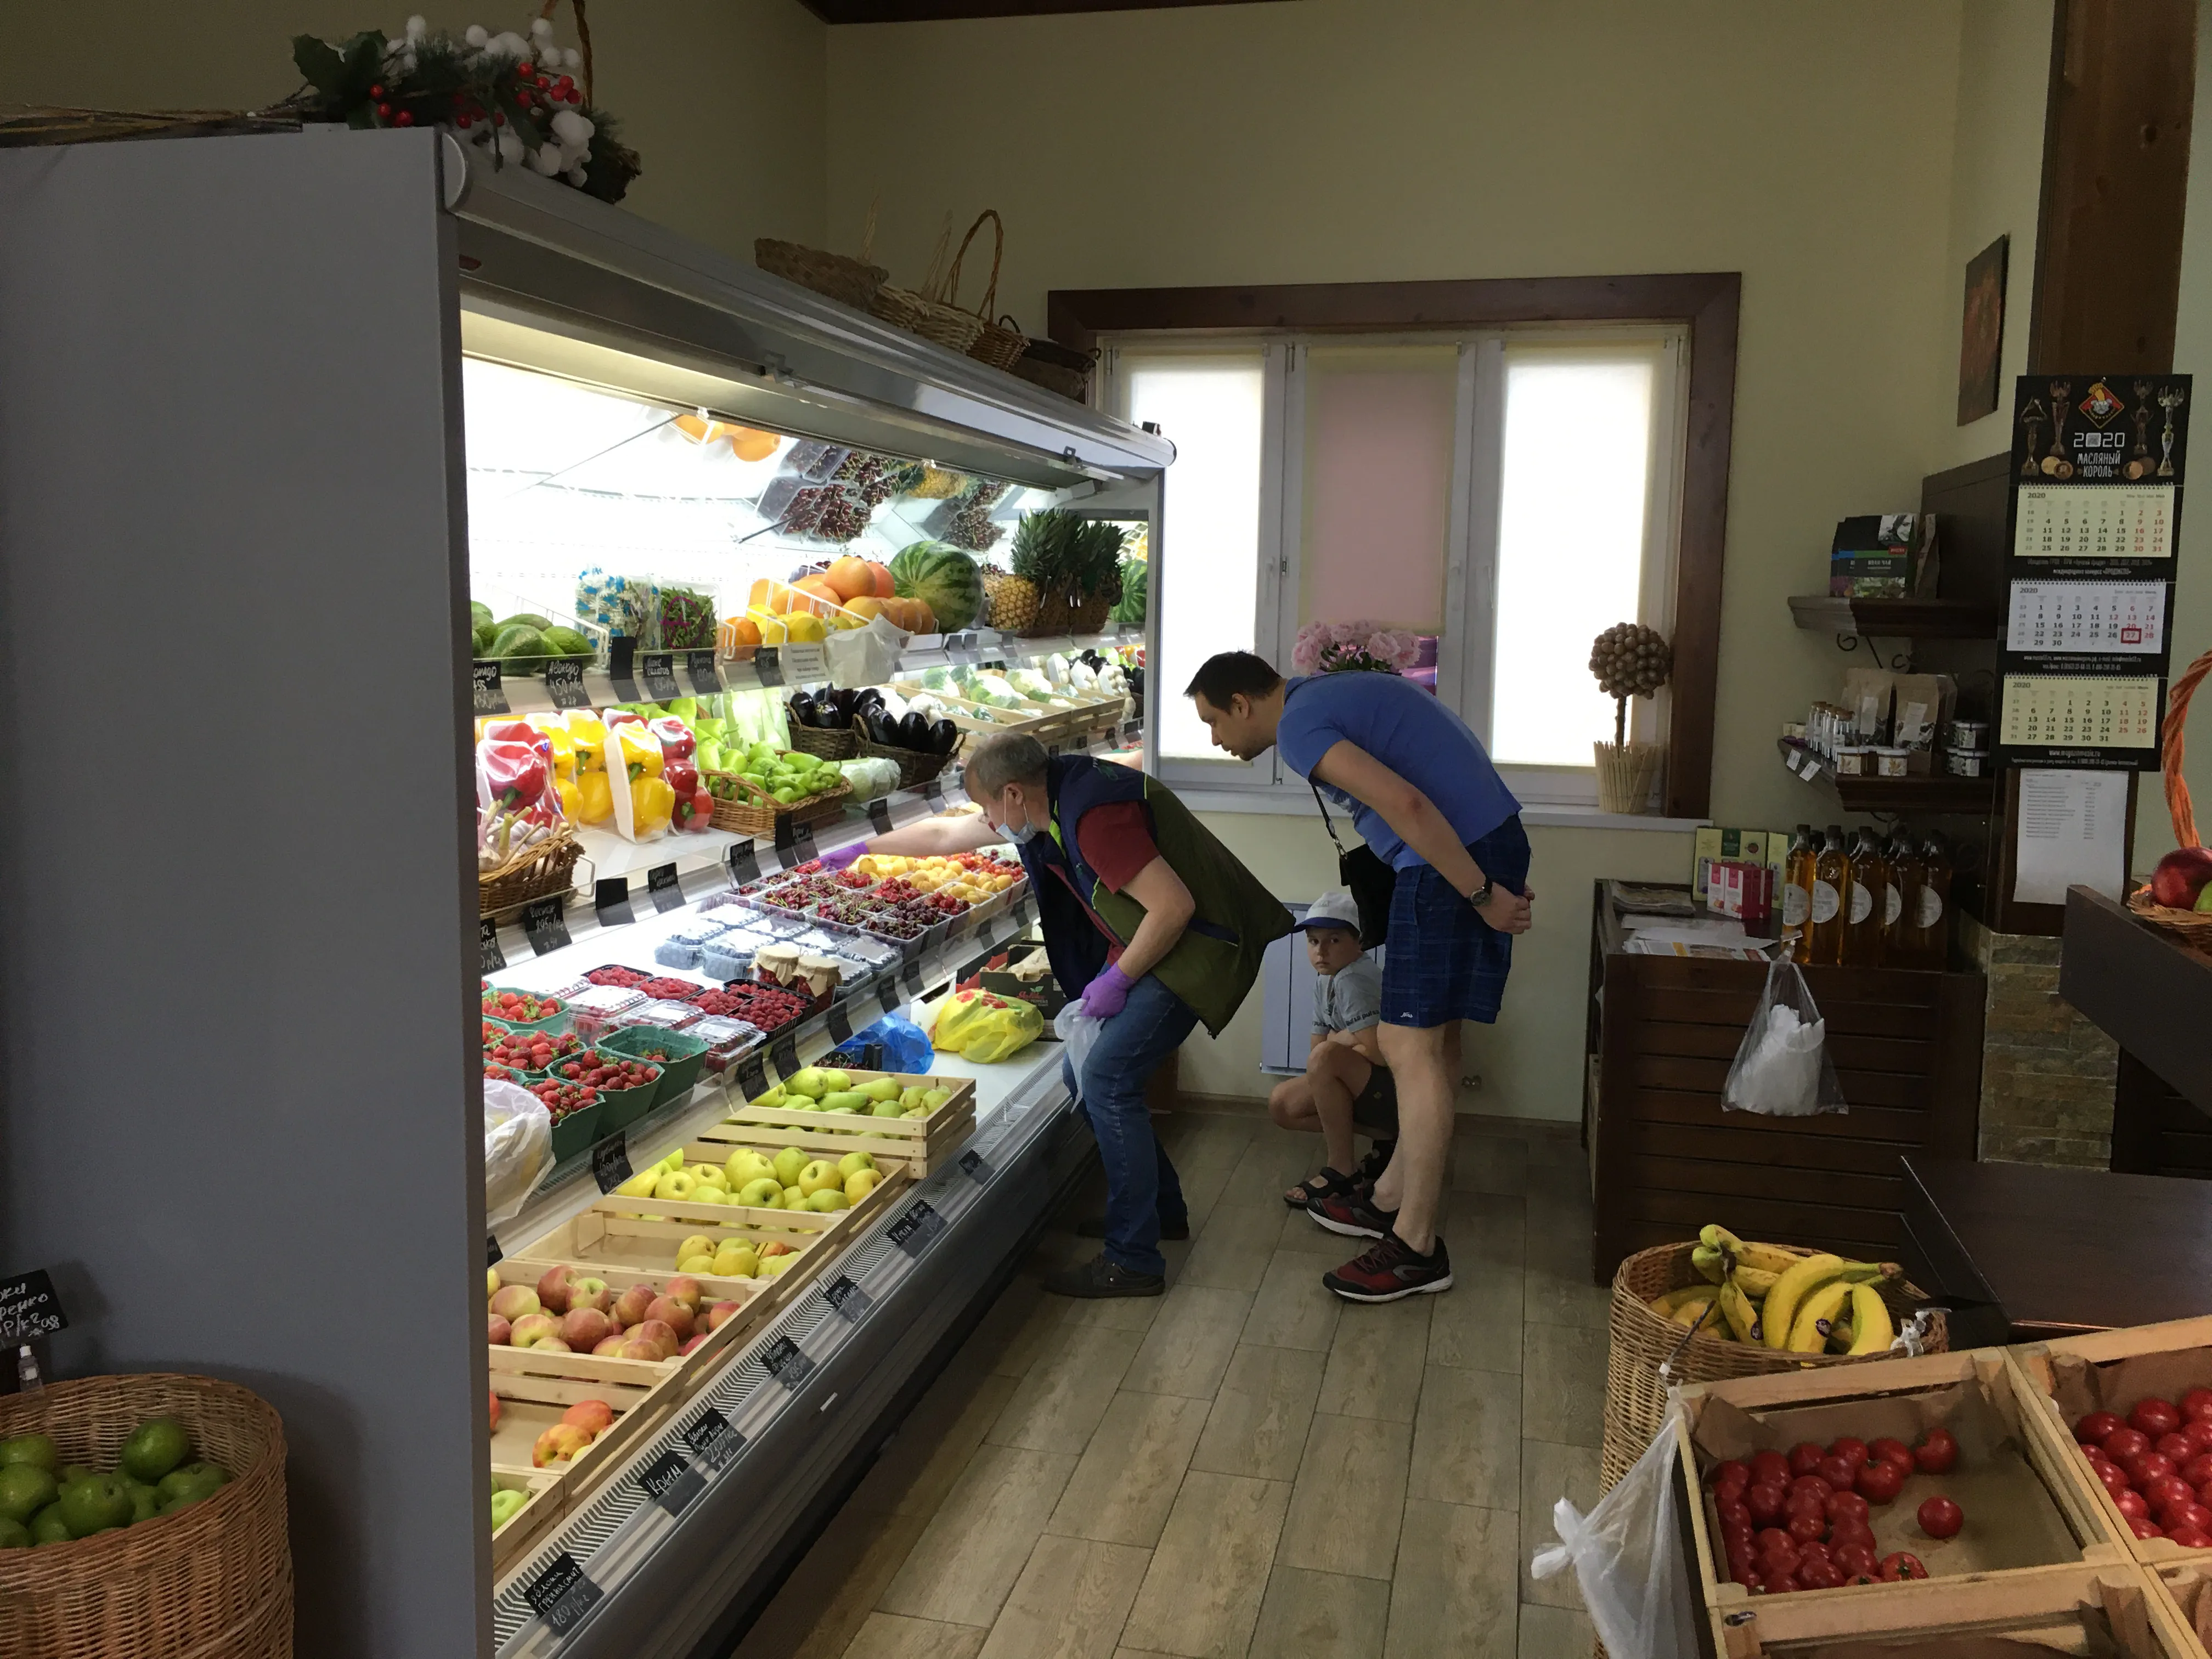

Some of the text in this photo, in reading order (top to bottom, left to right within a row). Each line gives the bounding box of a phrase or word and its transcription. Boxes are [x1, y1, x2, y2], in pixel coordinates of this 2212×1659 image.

[2073, 432, 2125, 448] 2020
[2077, 450, 2121, 465] МАСЛЯНЫЙ
[2083, 465, 2113, 477] КОРОЛЬ
[646, 1463, 684, 1497] Крым
